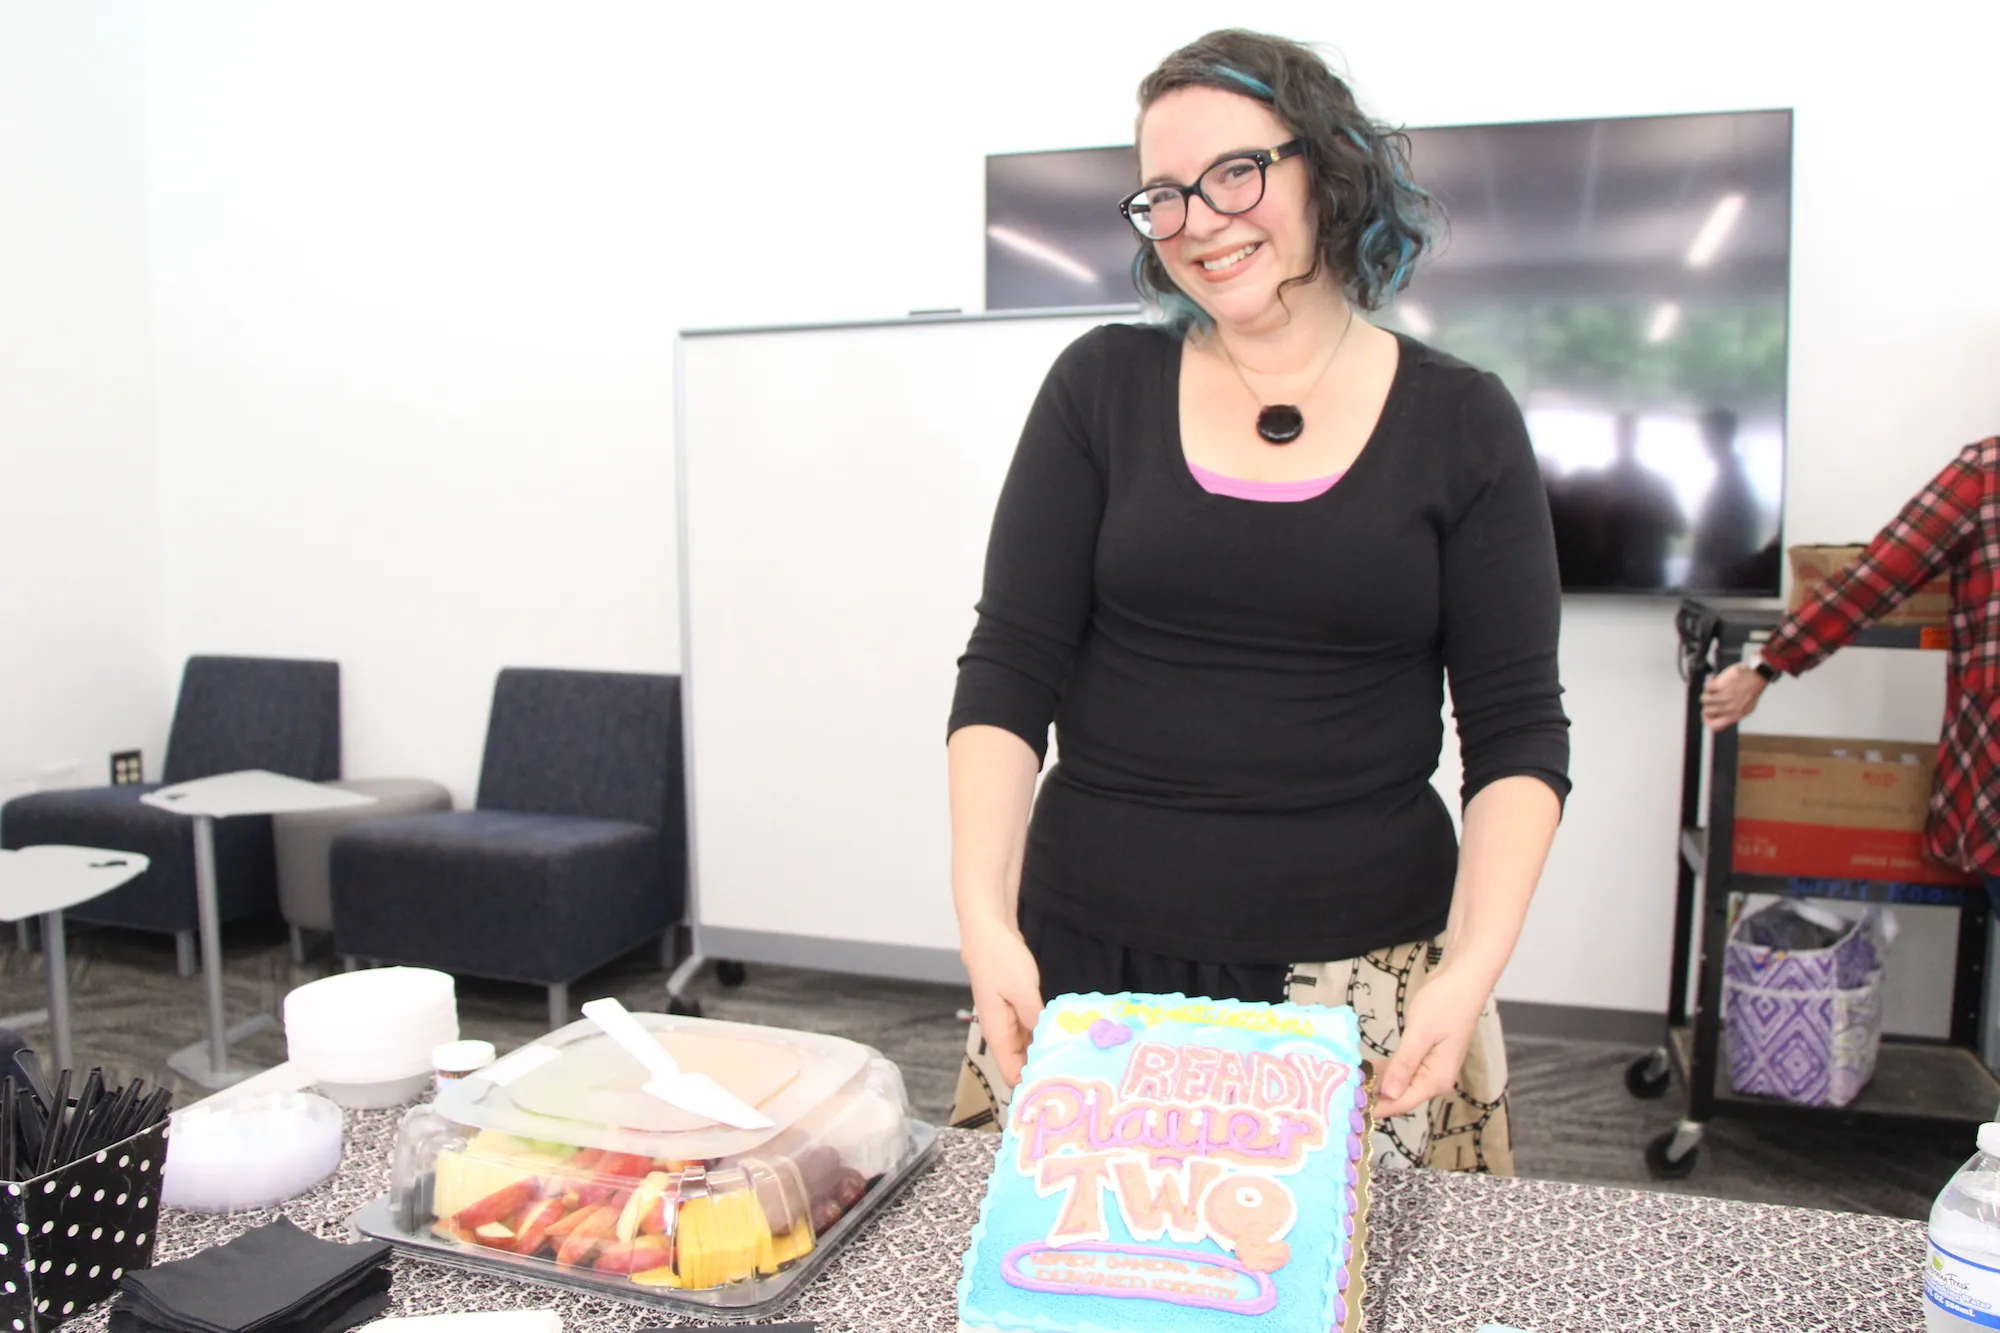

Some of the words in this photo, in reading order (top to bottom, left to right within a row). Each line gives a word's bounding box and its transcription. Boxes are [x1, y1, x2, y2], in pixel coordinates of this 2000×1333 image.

[1120, 1042, 1352, 1122] READY
[1019, 1084, 1318, 1167] Player
[1961, 1293, 1992, 1310] Water
